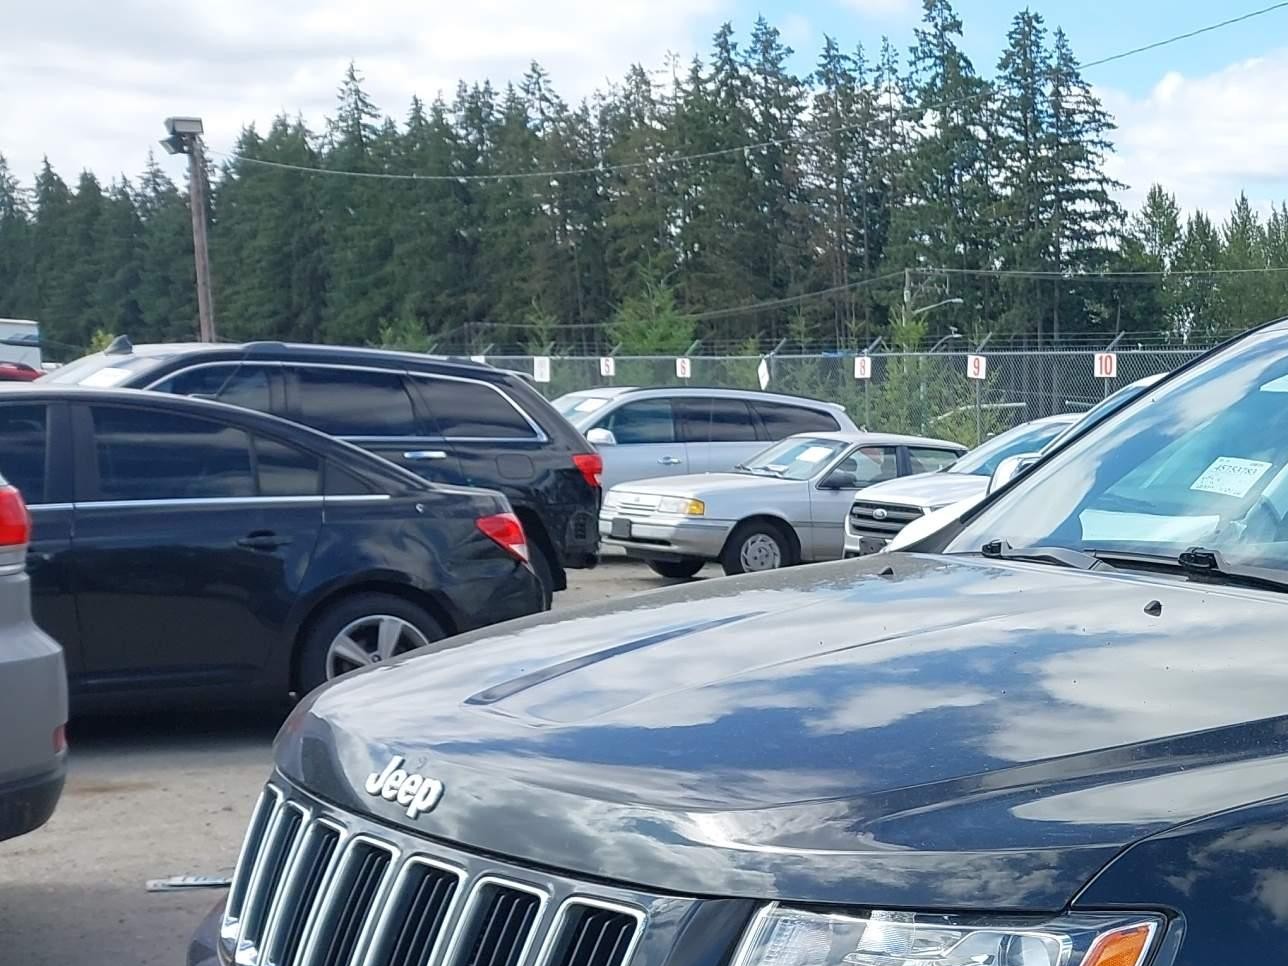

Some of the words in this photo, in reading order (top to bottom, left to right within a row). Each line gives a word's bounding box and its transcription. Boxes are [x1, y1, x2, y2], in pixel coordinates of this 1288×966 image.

[973, 357, 980, 376] 9
[1098, 354, 1113, 375] 10
[365, 755, 445, 820] Jeep
